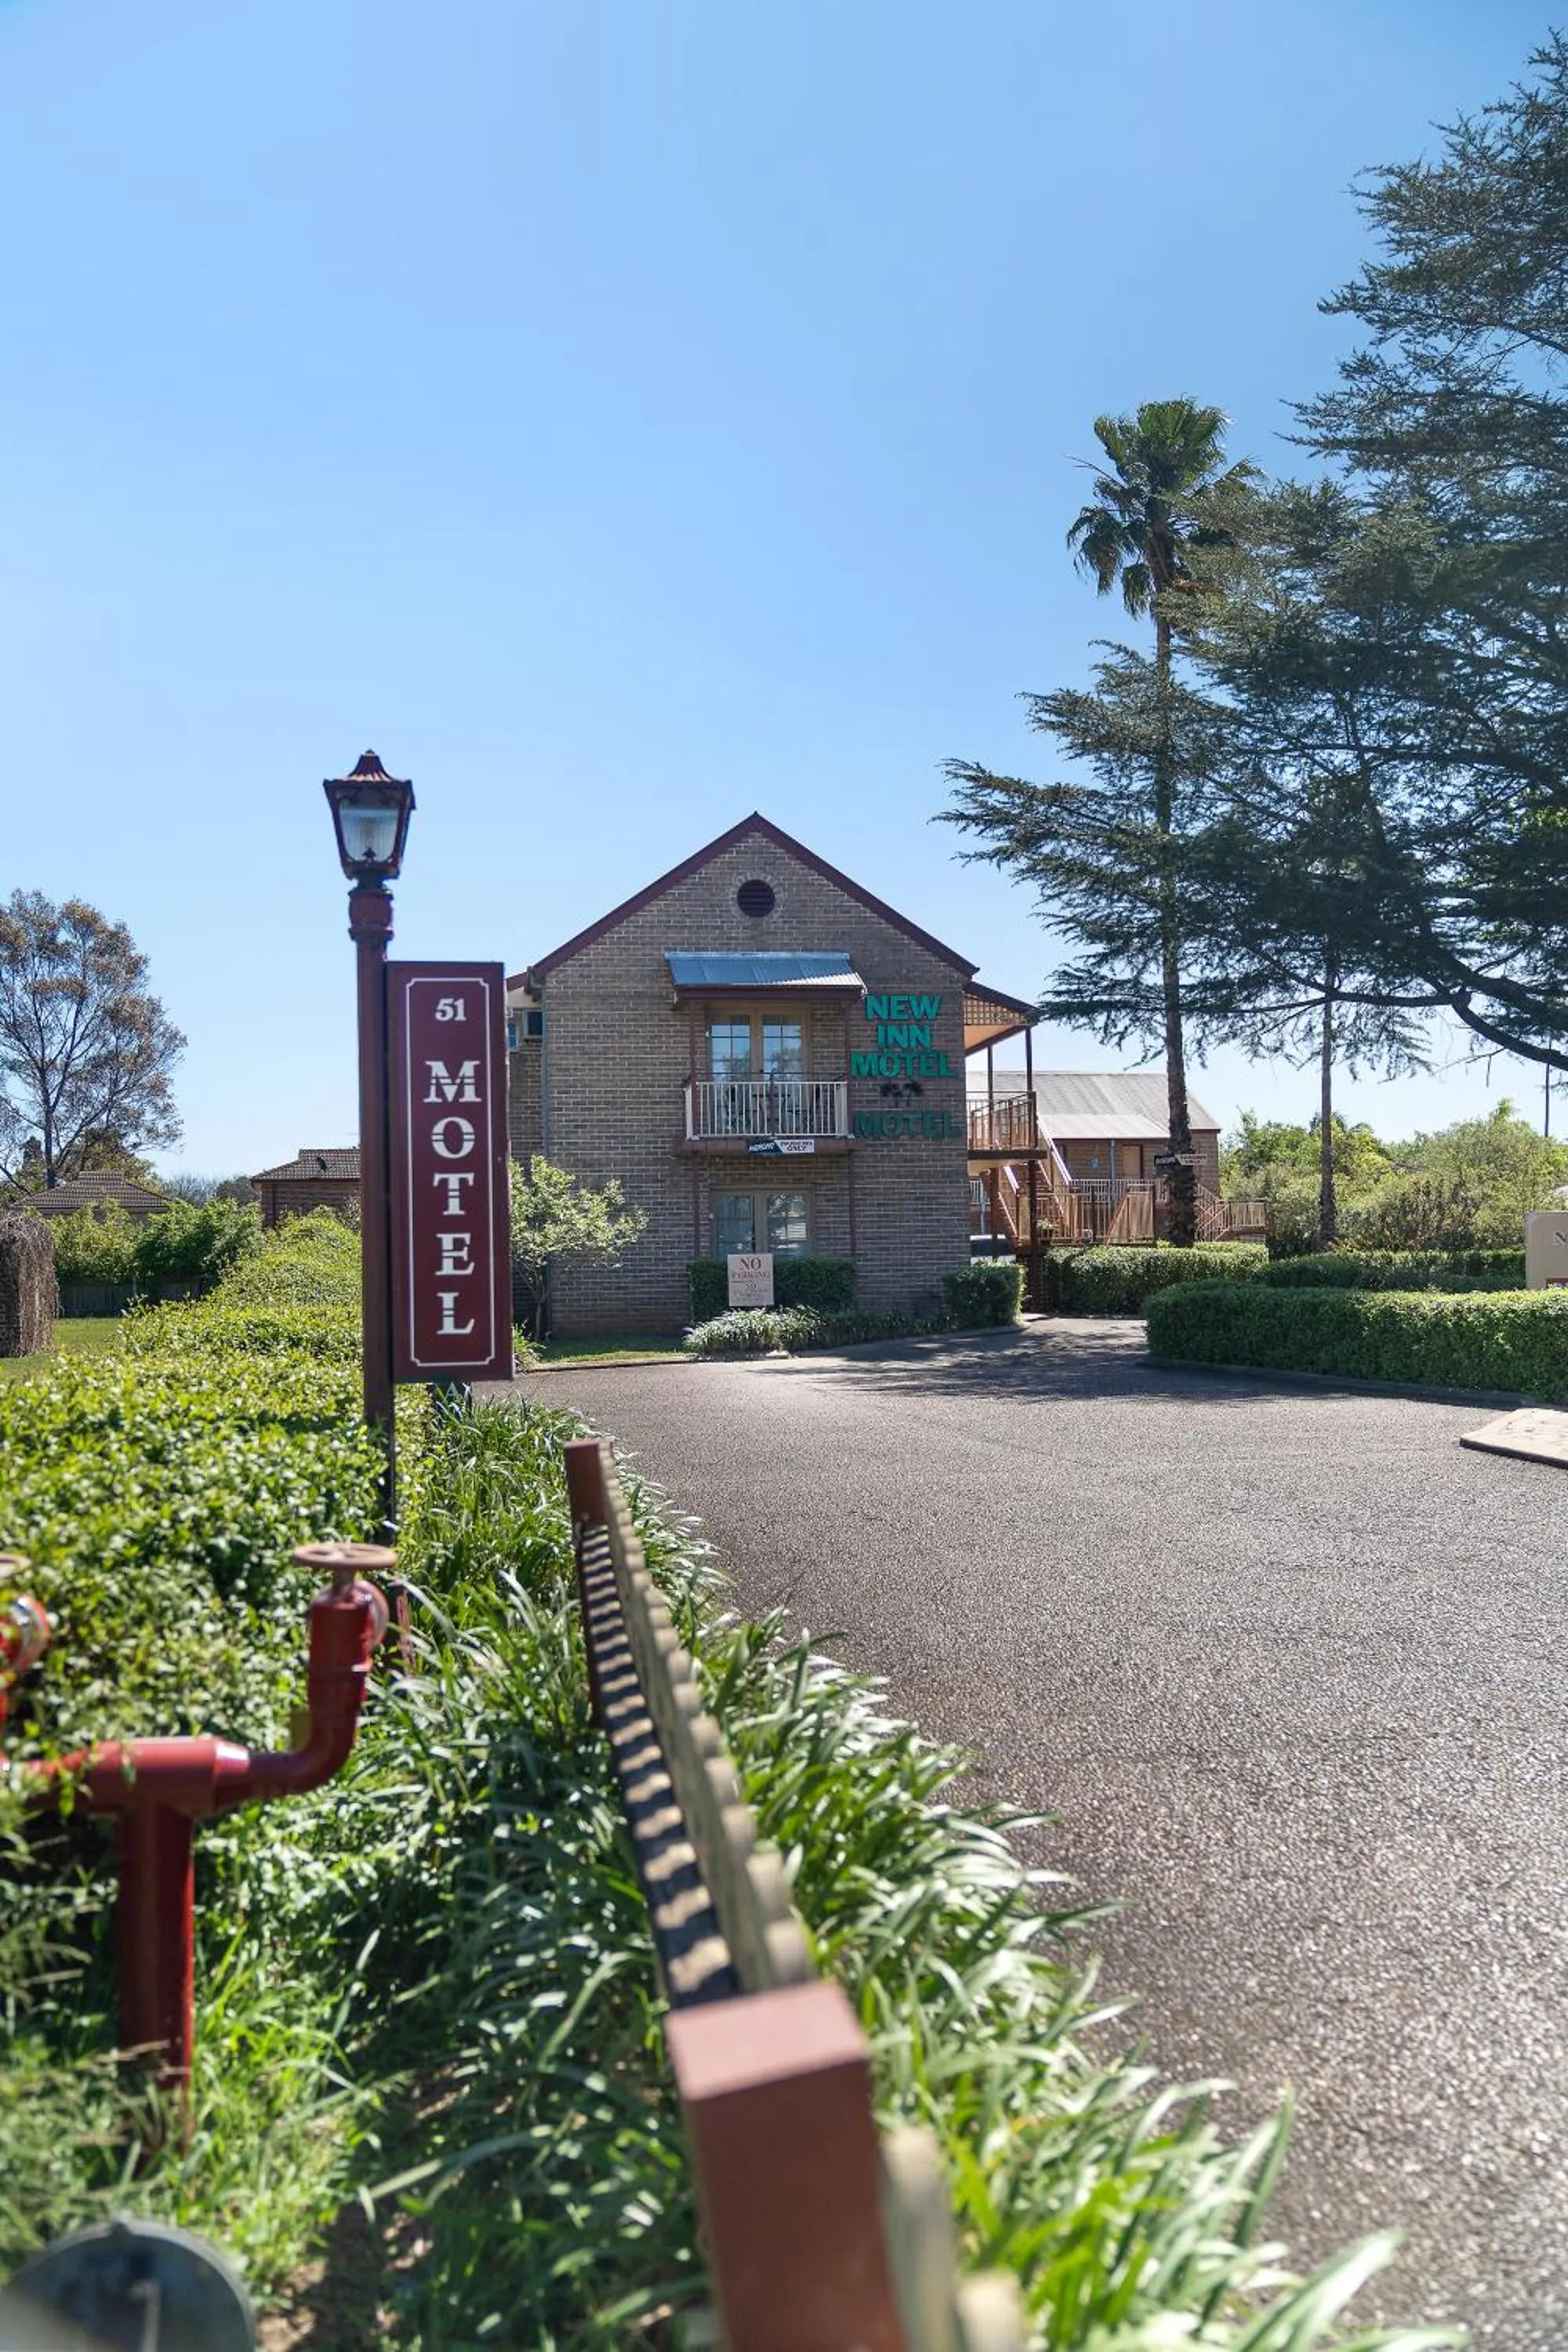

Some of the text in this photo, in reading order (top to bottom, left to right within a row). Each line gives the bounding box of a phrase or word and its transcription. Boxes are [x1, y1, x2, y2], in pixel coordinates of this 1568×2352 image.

[435, 997, 467, 1022] 51
[865, 993, 941, 1022] NEW
[876, 1023, 931, 1048] INN
[850, 1051, 960, 1079] MOTEL
[853, 1110, 964, 1139] MOTEL
[423, 1061, 482, 1335] MOTEL
[739, 1258, 761, 1270] NO
